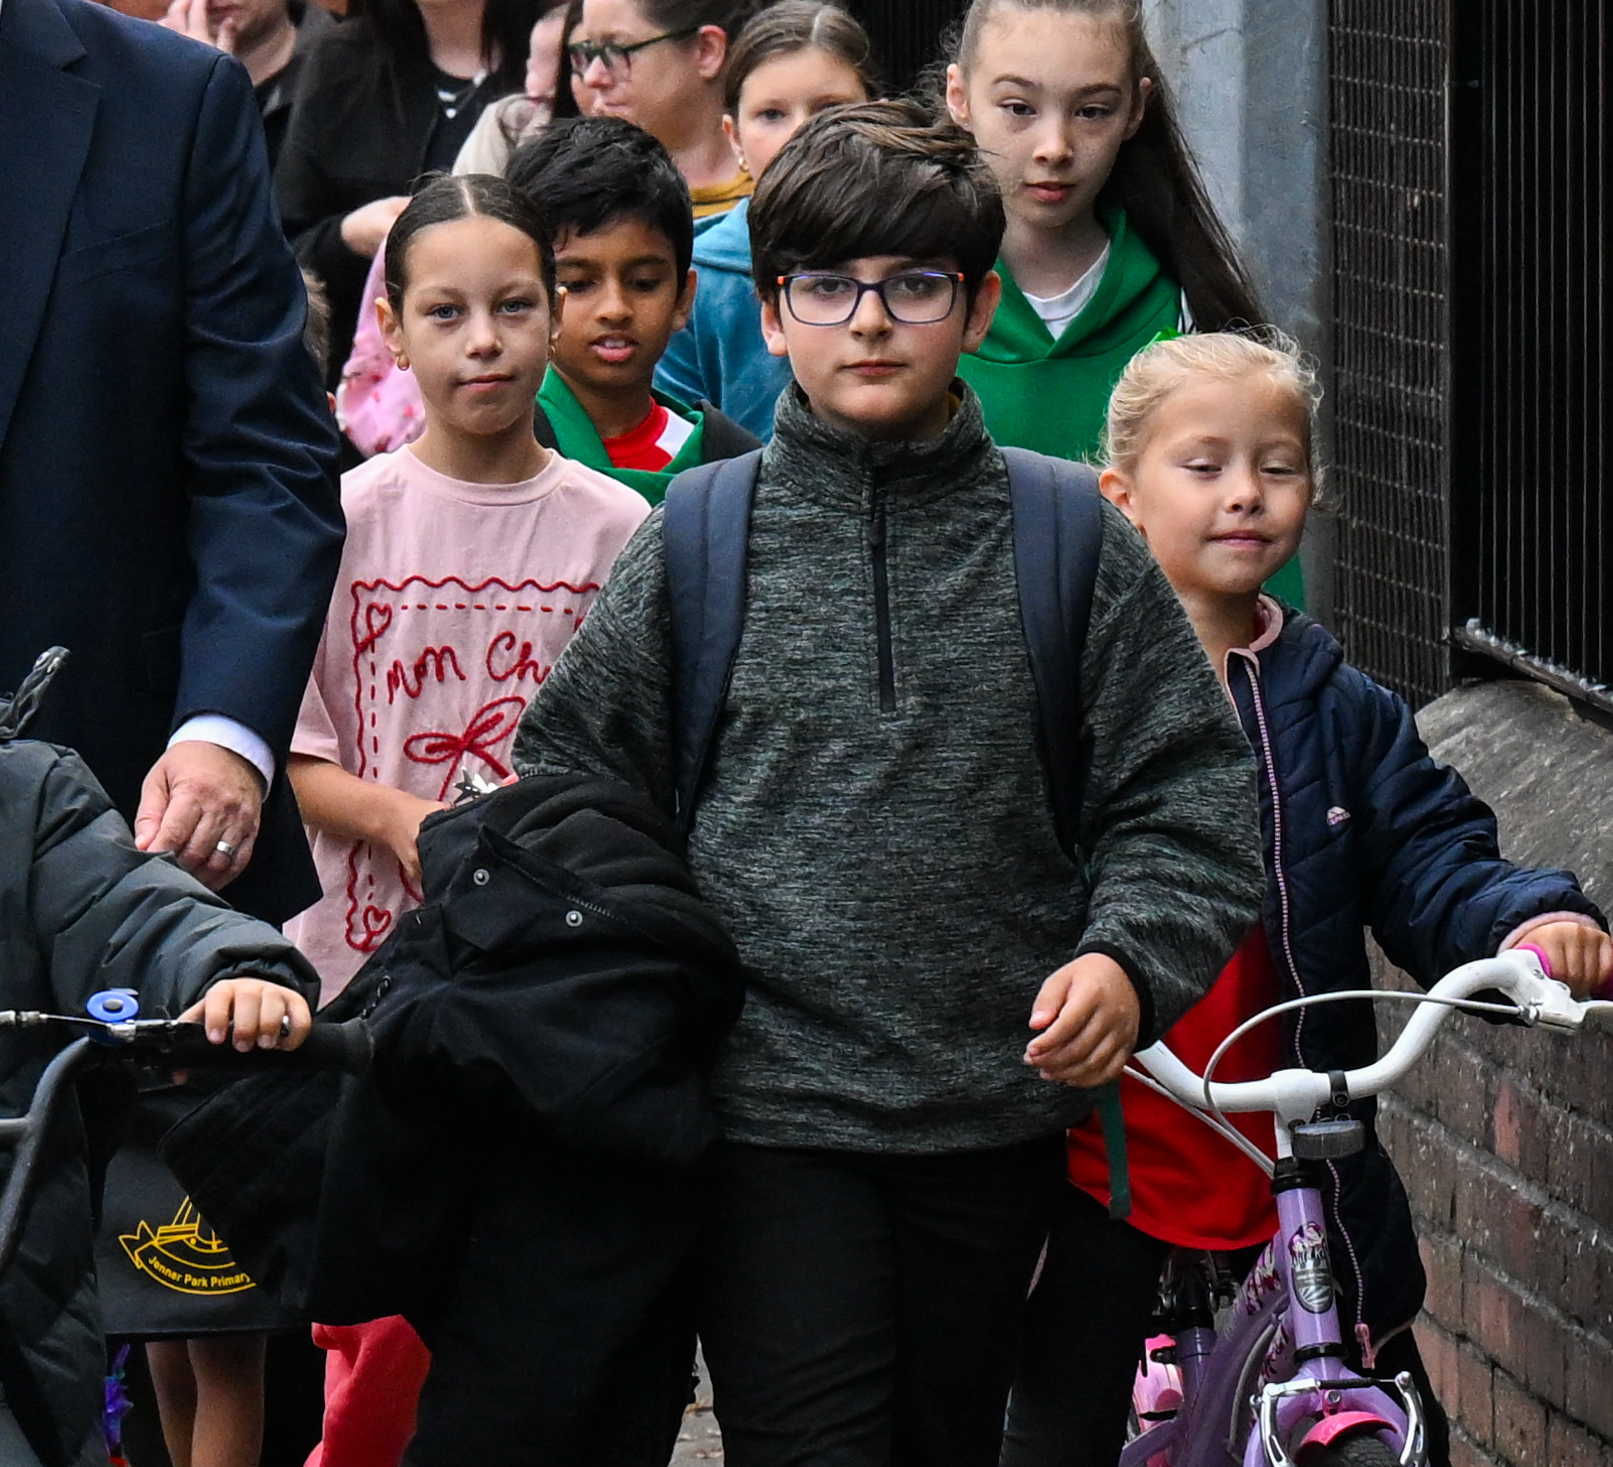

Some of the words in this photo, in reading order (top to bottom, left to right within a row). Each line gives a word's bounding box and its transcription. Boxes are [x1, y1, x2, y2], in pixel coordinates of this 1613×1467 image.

[486, 630, 553, 685] Ch
[148, 1255, 183, 1282] Jenner
[184, 1273, 208, 1288] Park
